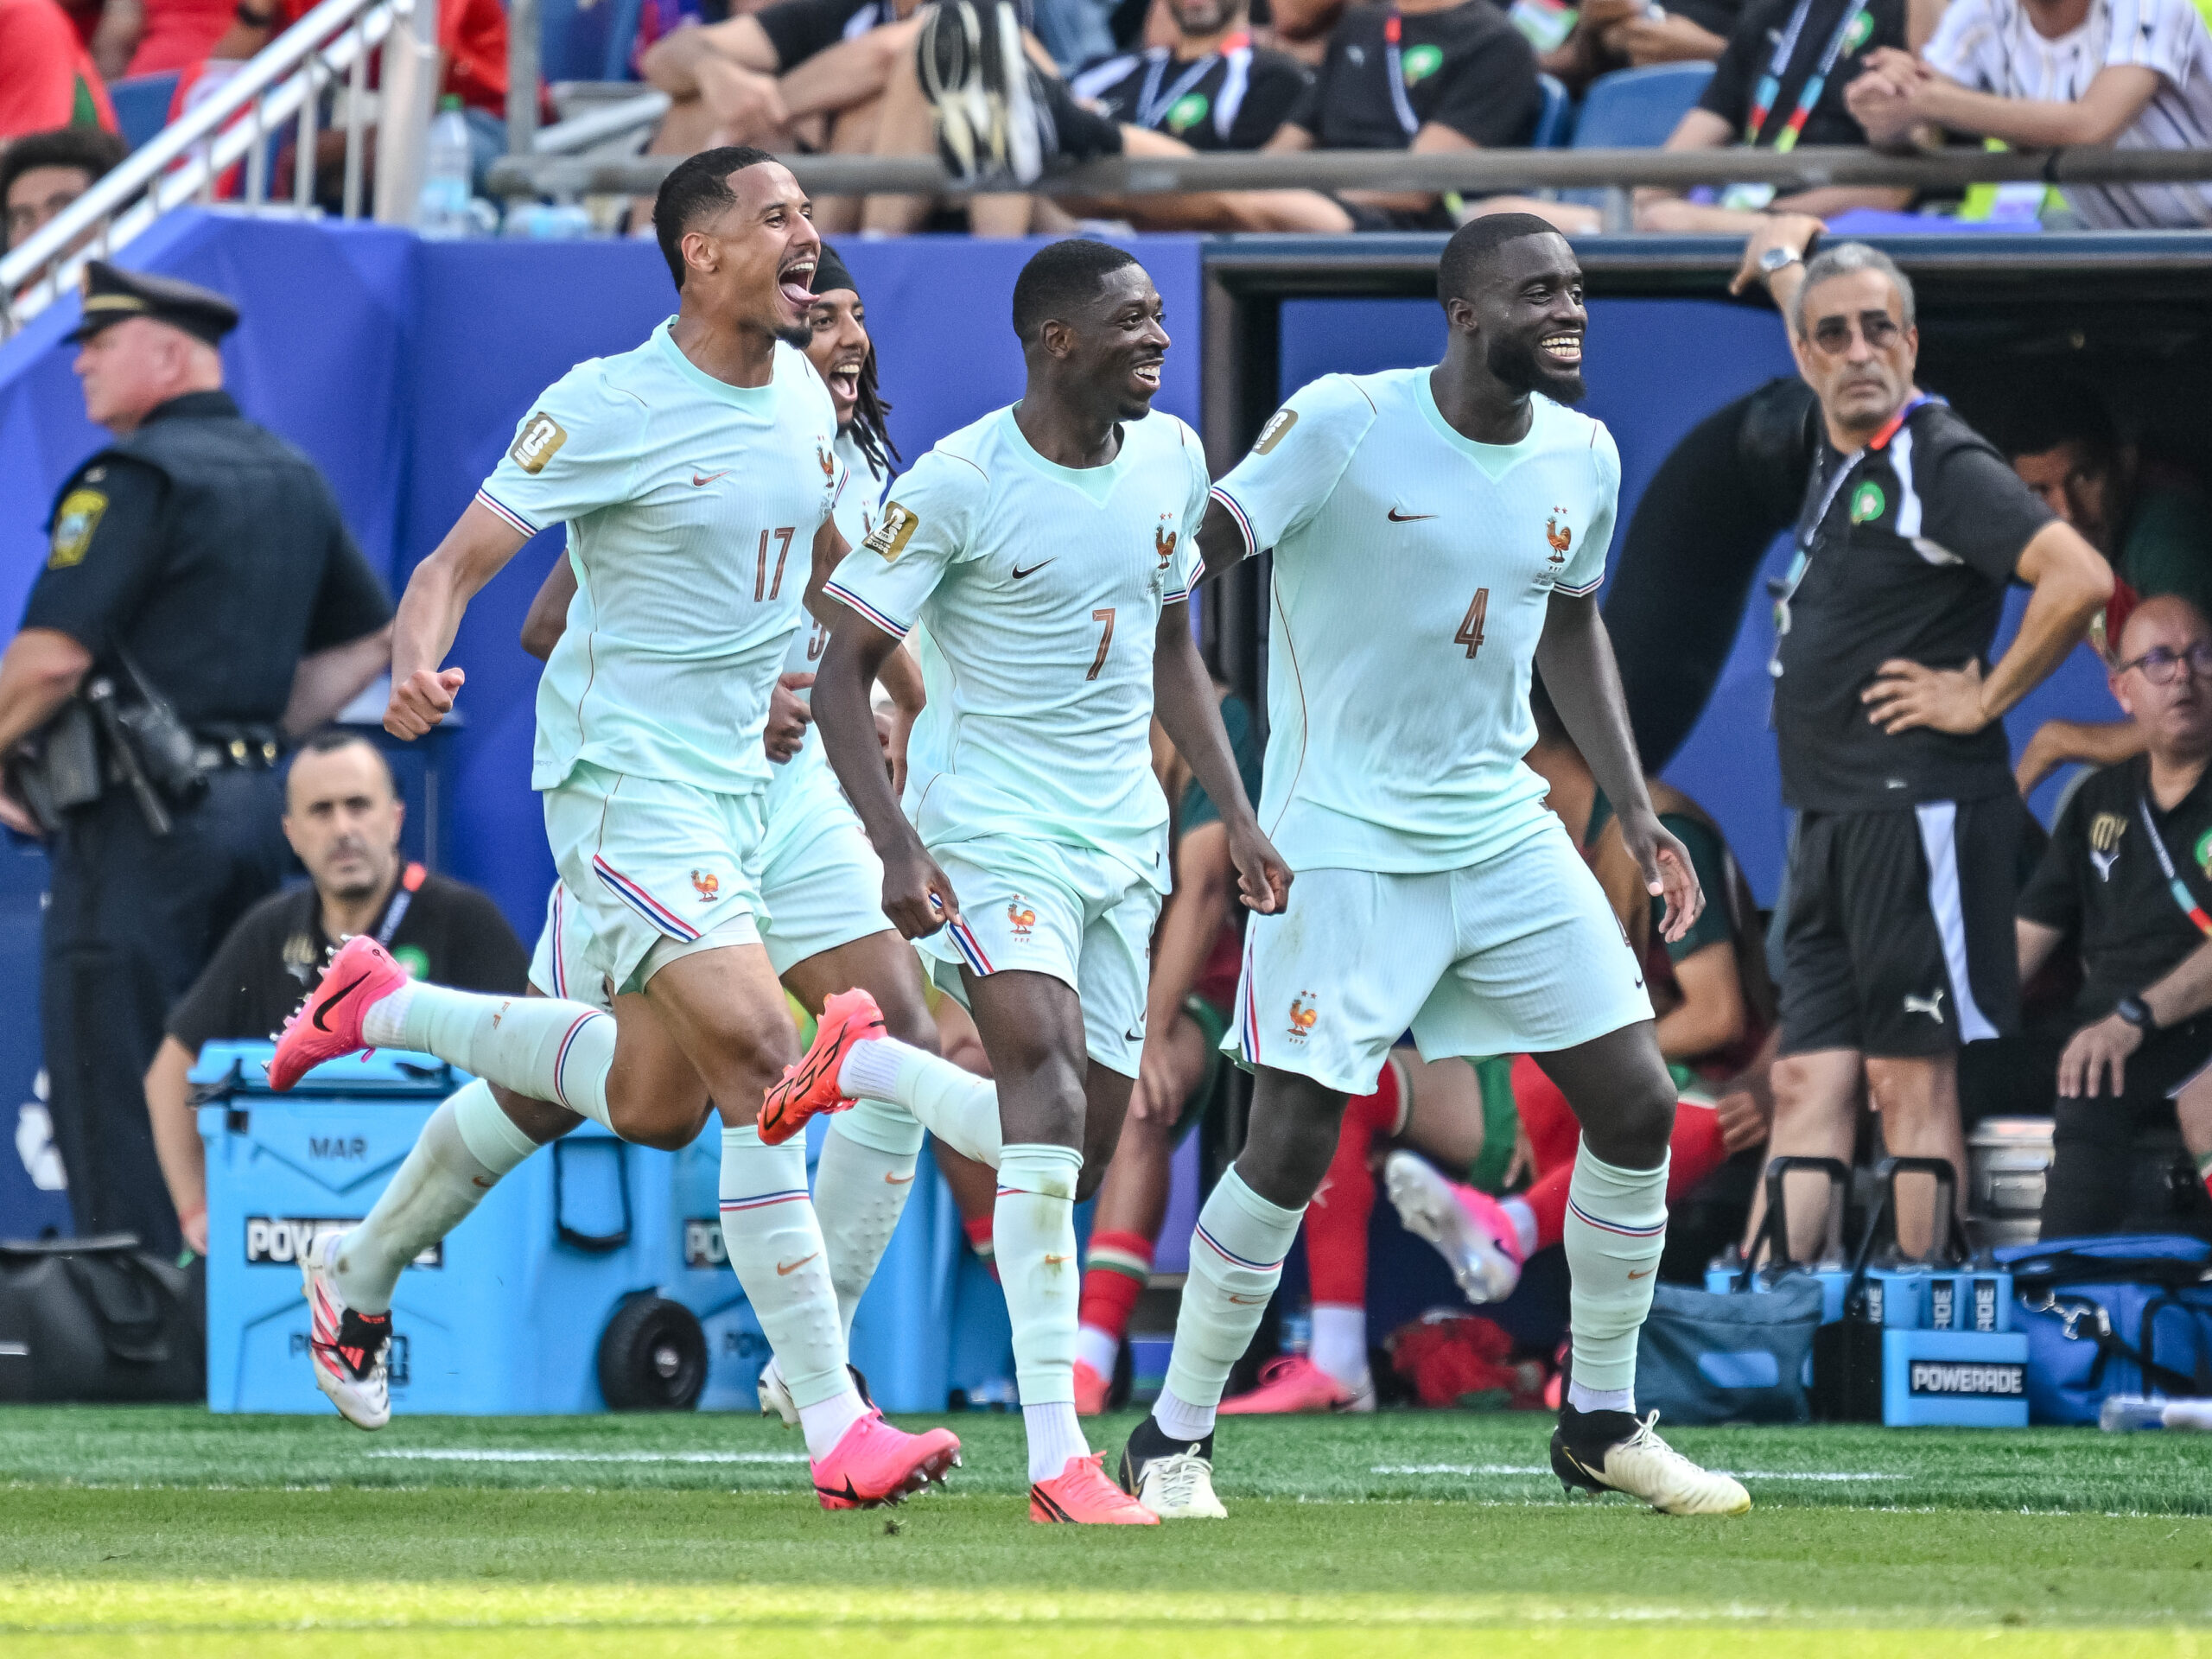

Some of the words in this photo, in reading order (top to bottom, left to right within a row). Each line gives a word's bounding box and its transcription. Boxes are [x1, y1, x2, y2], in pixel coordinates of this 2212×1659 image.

[753, 526, 796, 602] 17
[1084, 607, 1116, 682] 7
[1453, 587, 1490, 659] 4
[309, 1138, 366, 1158] MAR
[1911, 1364, 2023, 1394] POWERADE
